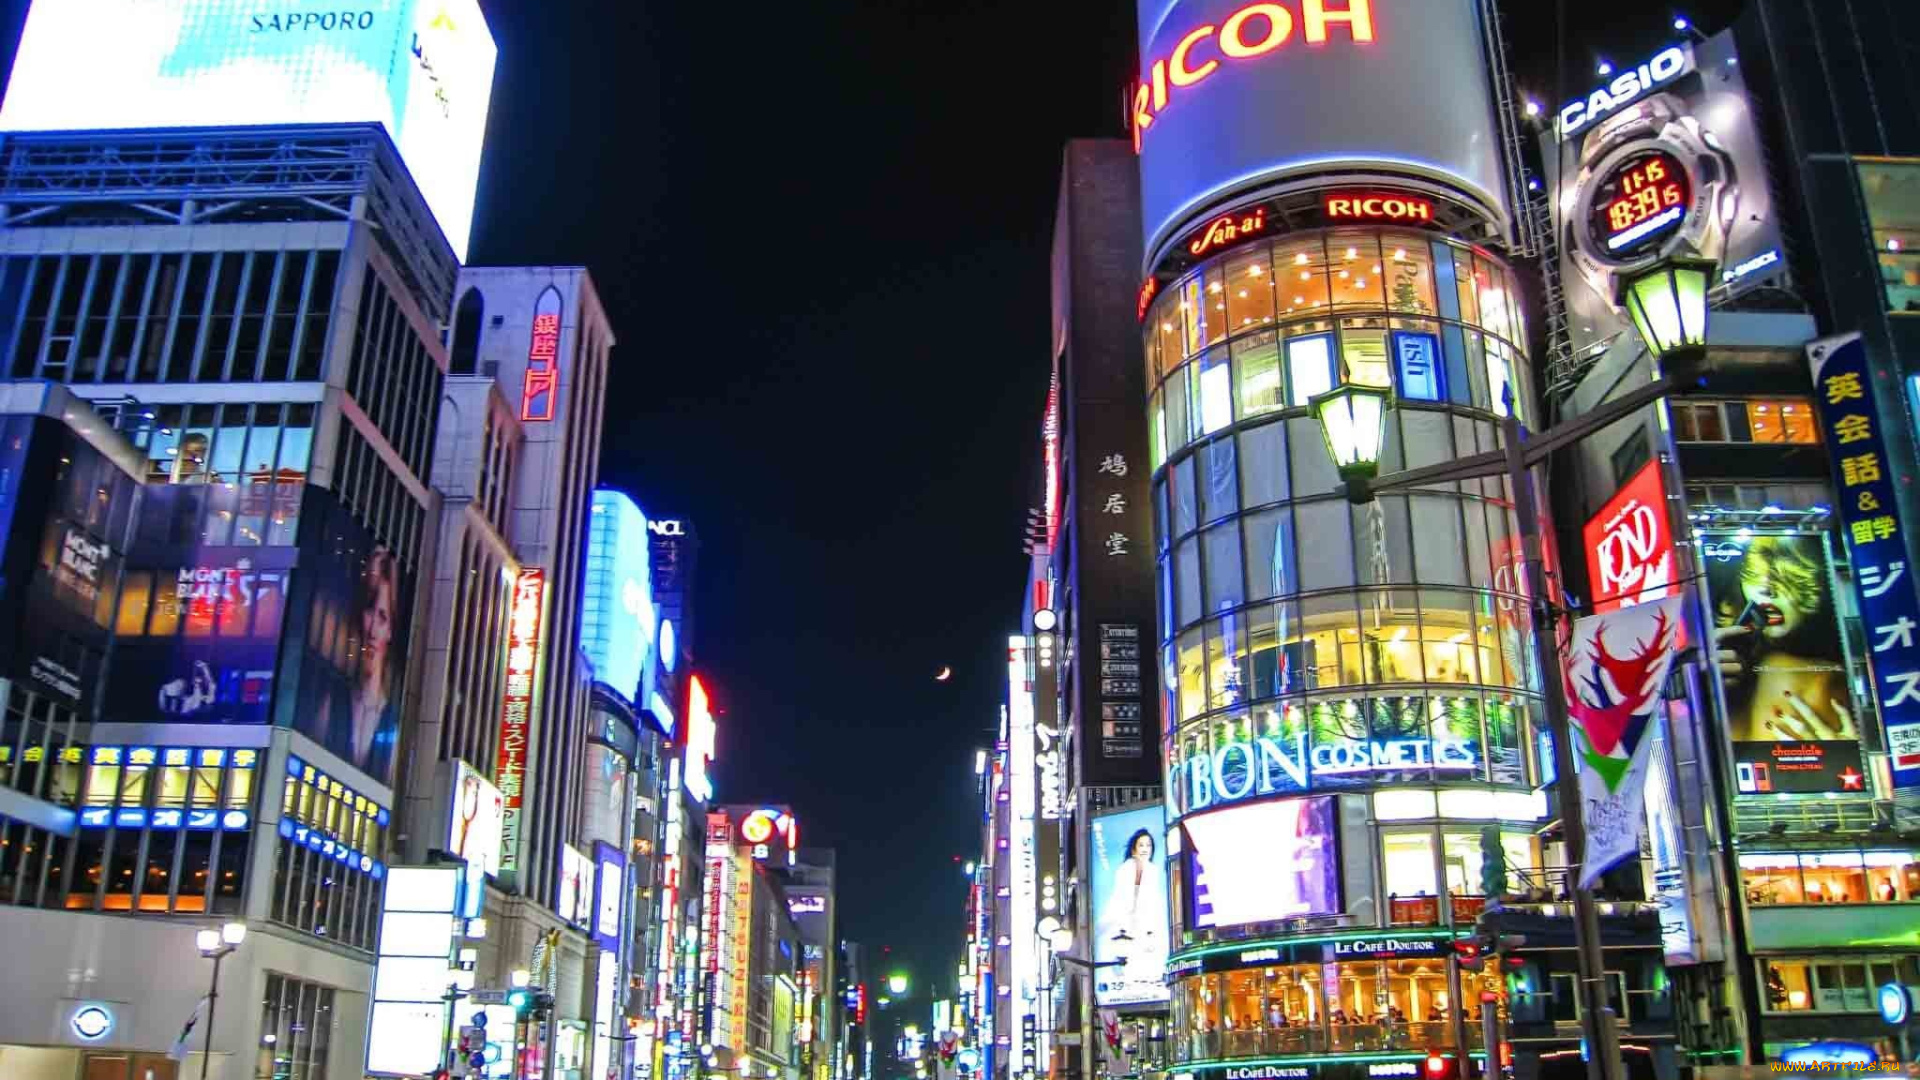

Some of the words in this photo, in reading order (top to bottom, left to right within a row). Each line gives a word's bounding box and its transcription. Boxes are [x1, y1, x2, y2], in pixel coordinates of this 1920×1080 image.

[249, 11, 374, 33] SAPPORO
[1134, 0, 1374, 154] RICOH
[1561, 48, 1684, 134] CASIO
[1328, 199, 1428, 219] RICOH
[1098, 453, 1129, 556] 鳩居堂
[1311, 740, 1475, 770] COSMETICS
